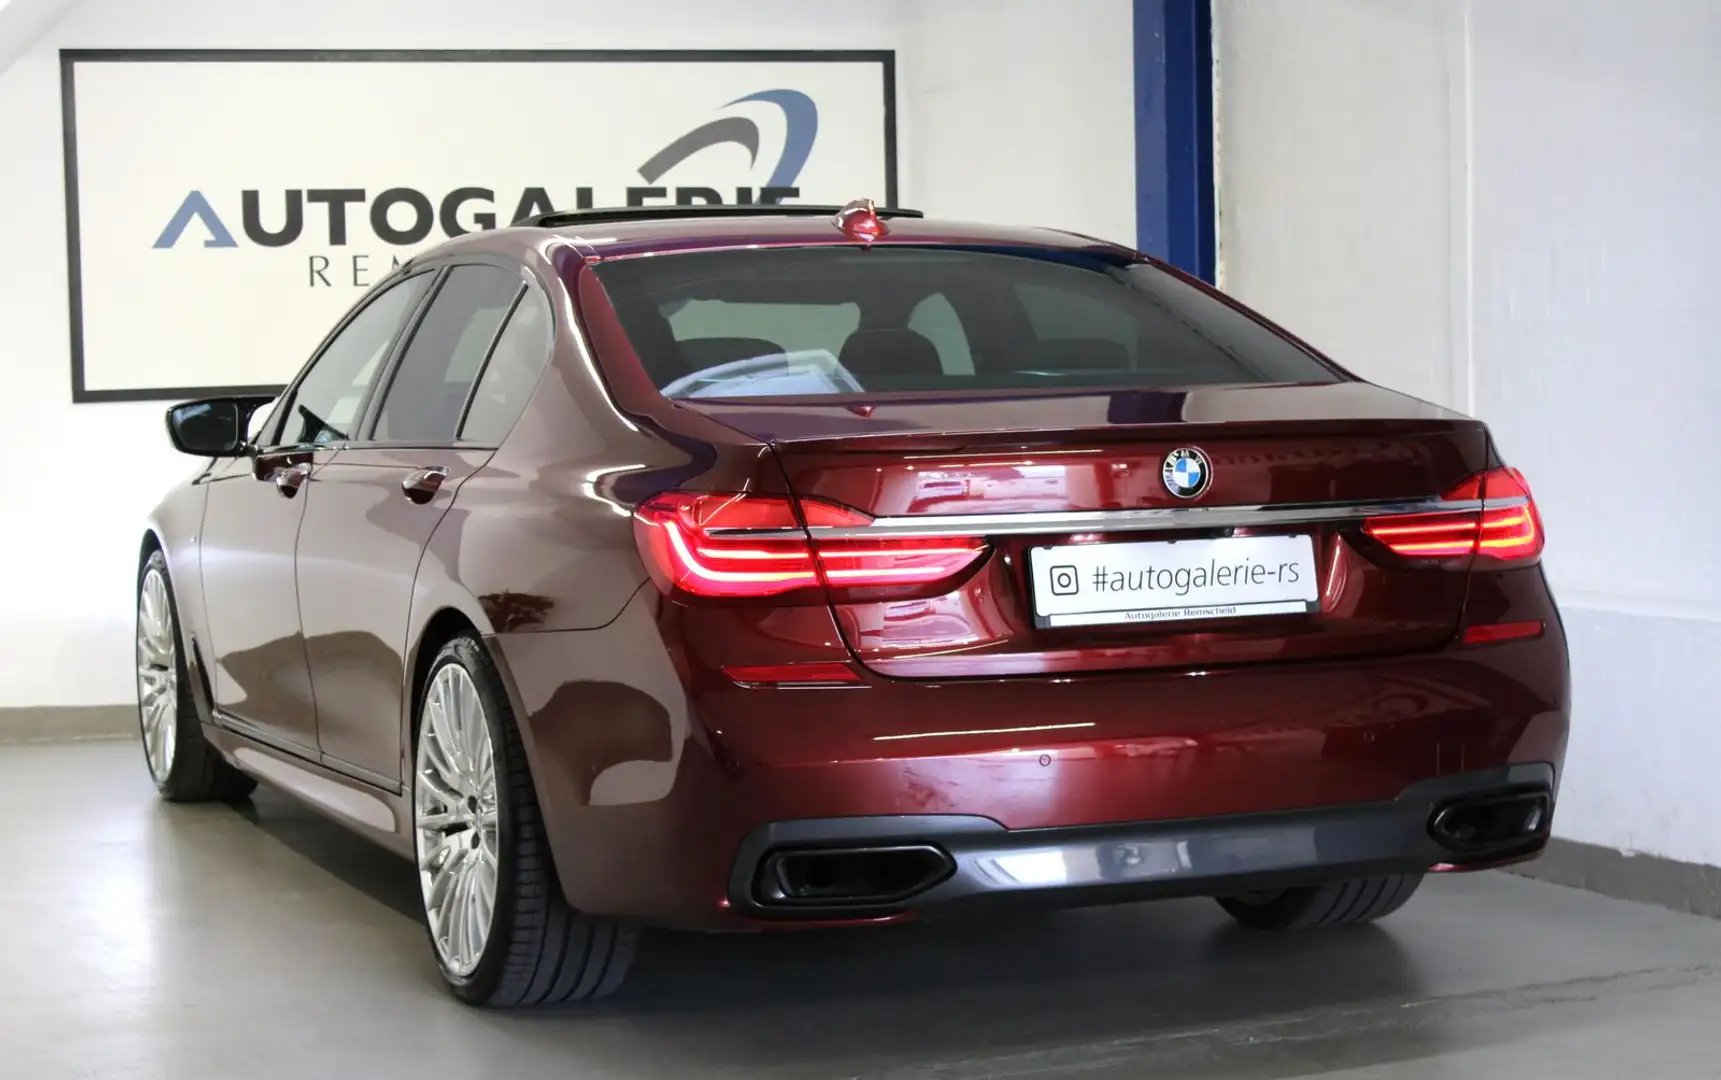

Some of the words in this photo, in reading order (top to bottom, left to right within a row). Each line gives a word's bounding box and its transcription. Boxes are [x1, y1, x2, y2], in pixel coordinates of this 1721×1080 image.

[1092, 557, 1300, 596] #autogalerie-rs
[1124, 610, 1181, 621] Autogalerie
[1183, 606, 1236, 617] Remscheid
